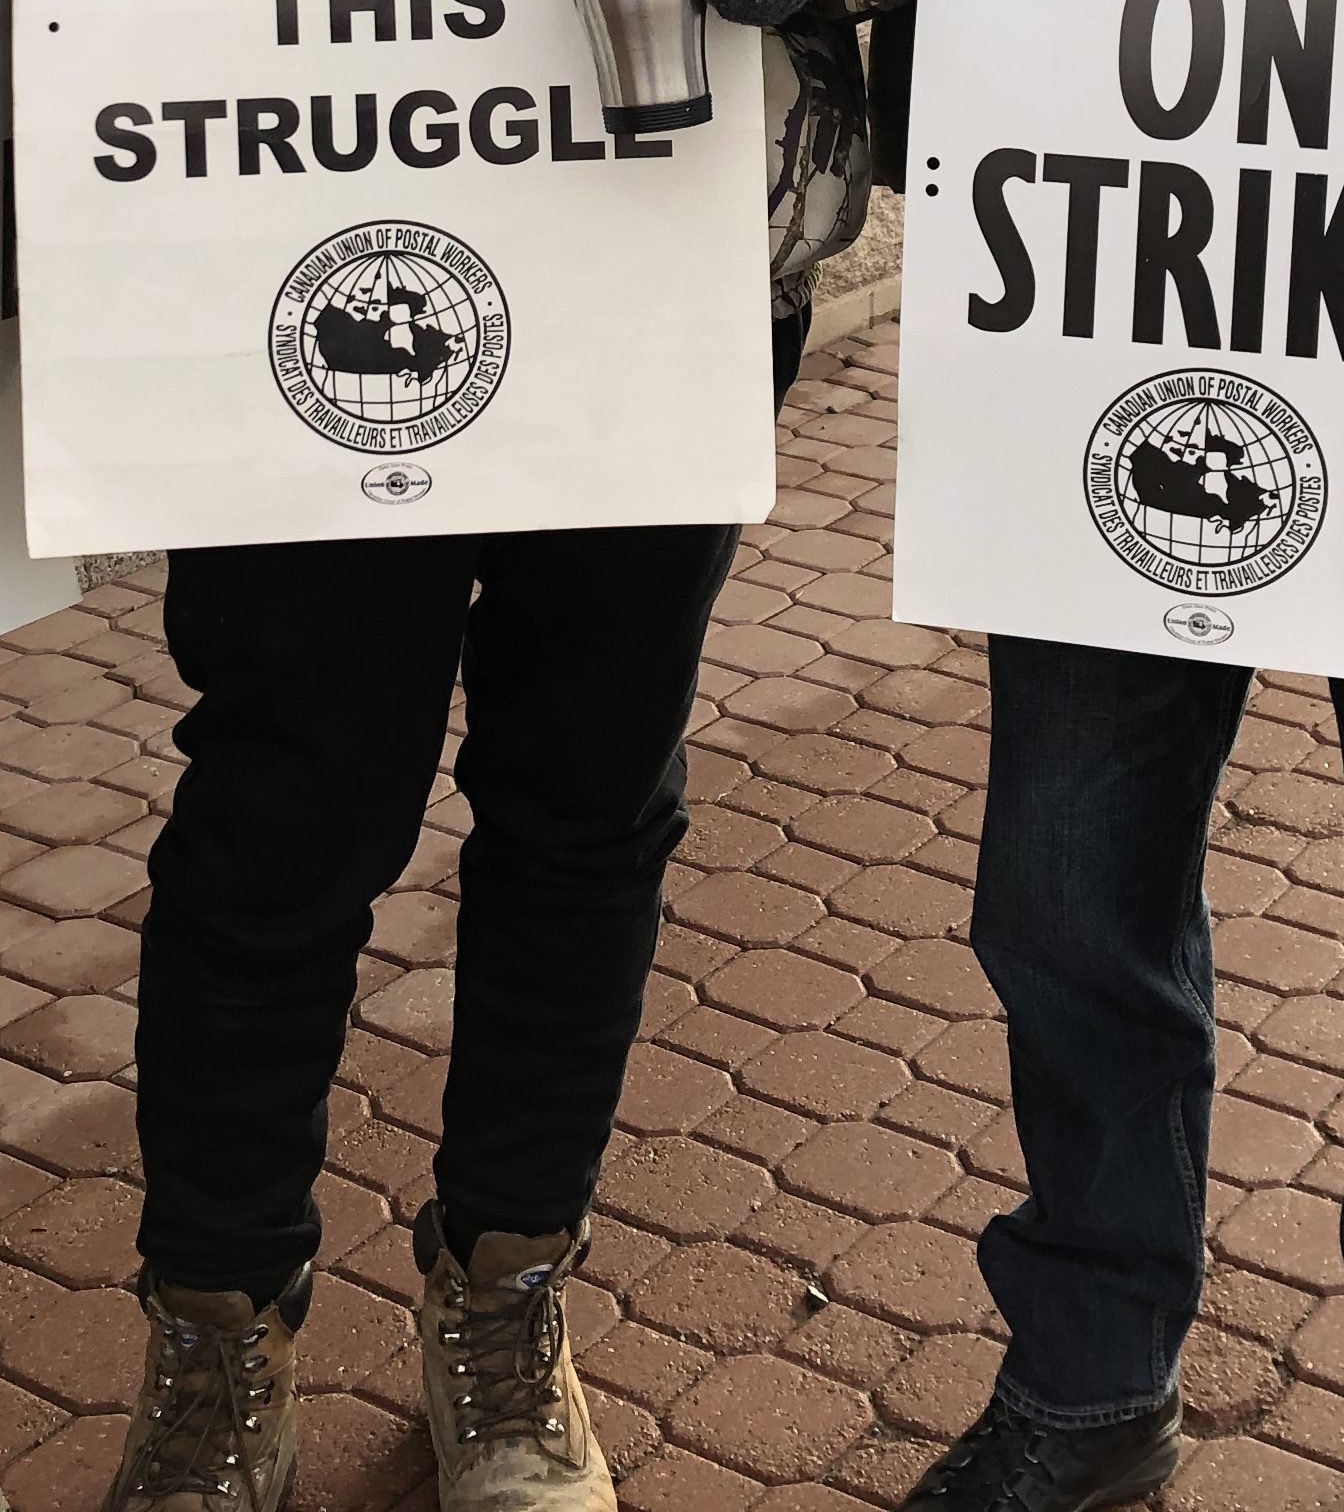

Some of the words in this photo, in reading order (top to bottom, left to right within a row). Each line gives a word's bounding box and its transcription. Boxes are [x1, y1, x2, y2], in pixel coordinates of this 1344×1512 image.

[284, 248, 338, 303] CANADIAN
[332, 230, 374, 262] UNION
[375, 228, 392, 249] OF
[394, 228, 441, 258] POSTAL
[440, 241, 493, 295] WORKERS
[275, 324, 304, 382] SYNDICAT
[482, 313, 505, 359] POSTES
[287, 379, 315, 406] DES
[474, 360, 500, 385] DES
[304, 397, 387, 449] TRAVAILLEURS
[389, 427, 403, 449] ET
[405, 381, 489, 446] TRAVAILLEUSES
[1103, 387, 1156, 437] CANADIAN
[1153, 375, 1195, 403] UNION
[1199, 375, 1215, 396] OF
[1217, 378, 1260, 411] POSTAL
[1260, 398, 1314, 455] WORKERS
[1090, 453, 1113, 508] SYNDICAT
[1299, 476, 1322, 519] POSTES
[1098, 508, 1126, 535] DES
[1286, 516, 1314, 542] DES
[1113, 529, 1194, 589] TRAVAILLEURS
[1195, 570, 1210, 590] ET
[1211, 538, 1300, 591] TRAVAILLEUSES
